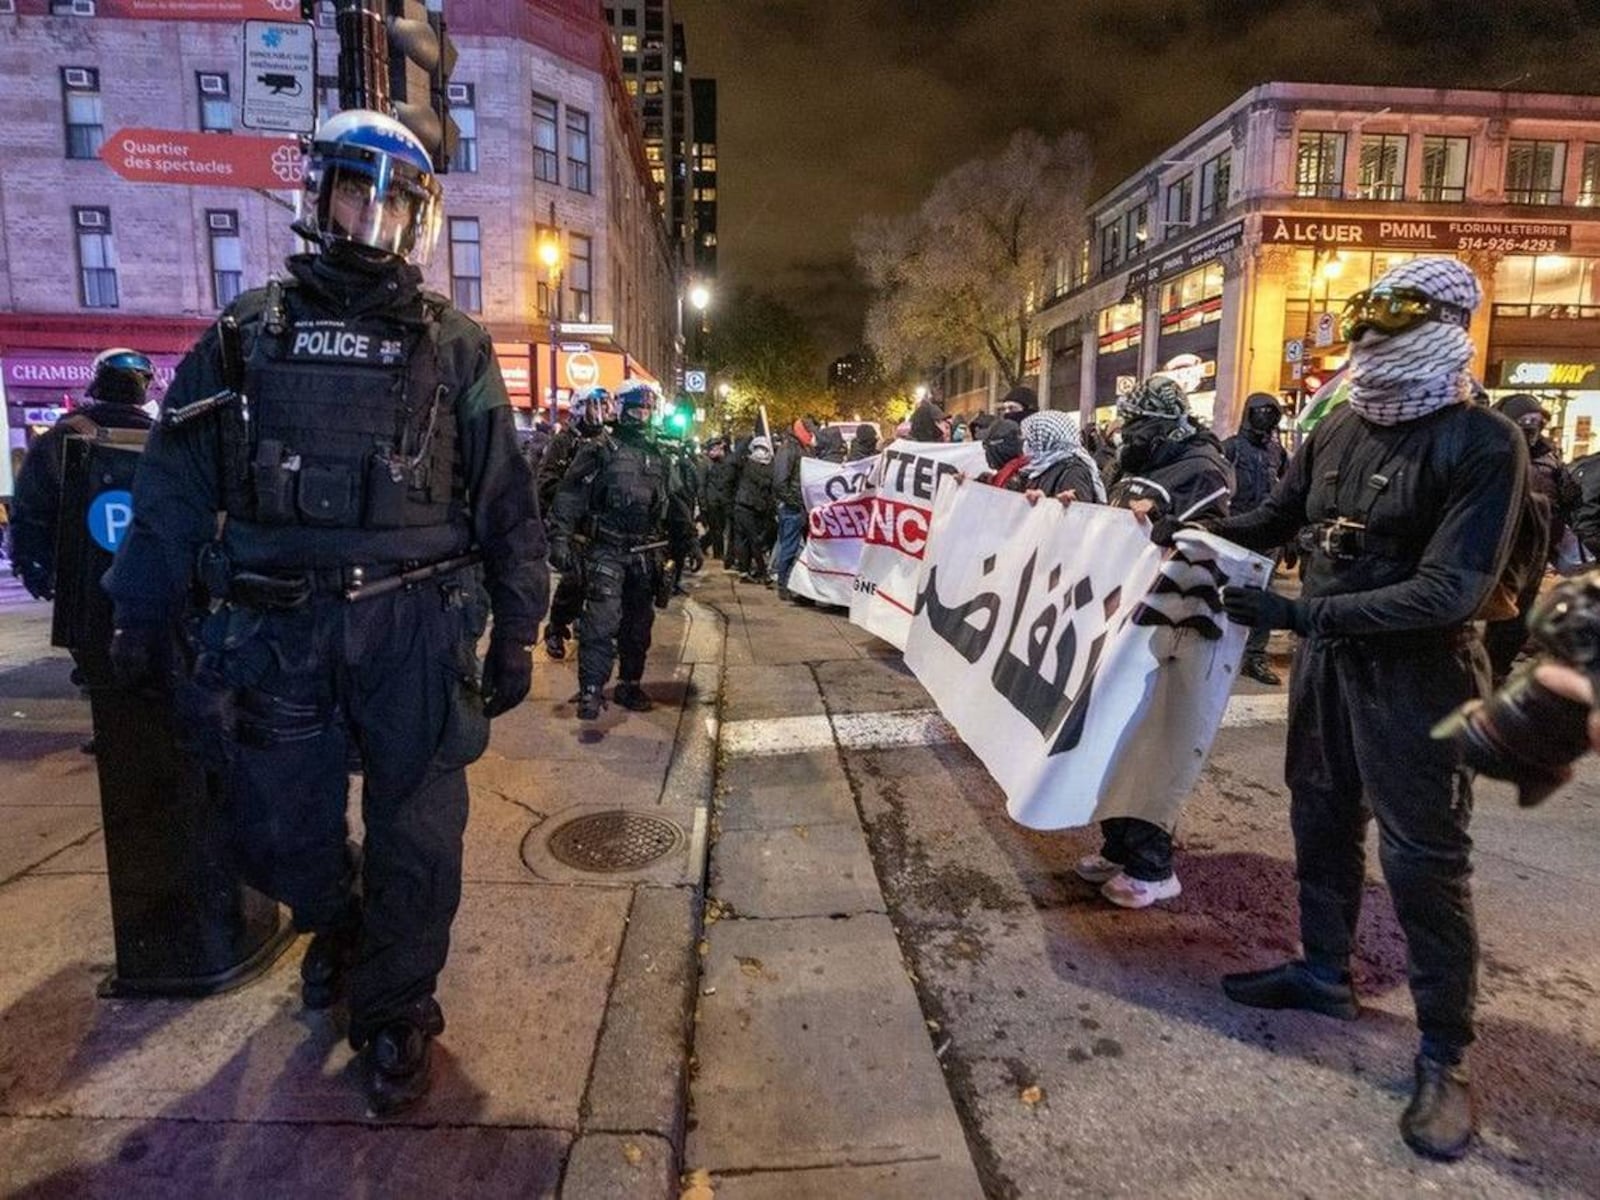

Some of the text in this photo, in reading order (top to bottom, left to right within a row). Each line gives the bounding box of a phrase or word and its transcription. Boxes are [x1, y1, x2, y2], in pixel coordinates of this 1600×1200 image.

[122, 139, 190, 156] Quartier
[124, 156, 234, 176] des spectacles
[1273, 218, 1291, 241] À
[1380, 222, 1438, 240] PMML
[1449, 223, 1568, 236] FLORIAN LETERRIER
[1457, 236, 1557, 252] 514-926-4293
[293, 331, 370, 358] POLICE
[1508, 363, 1595, 384] SUBWAY
[104, 503, 133, 543] P
